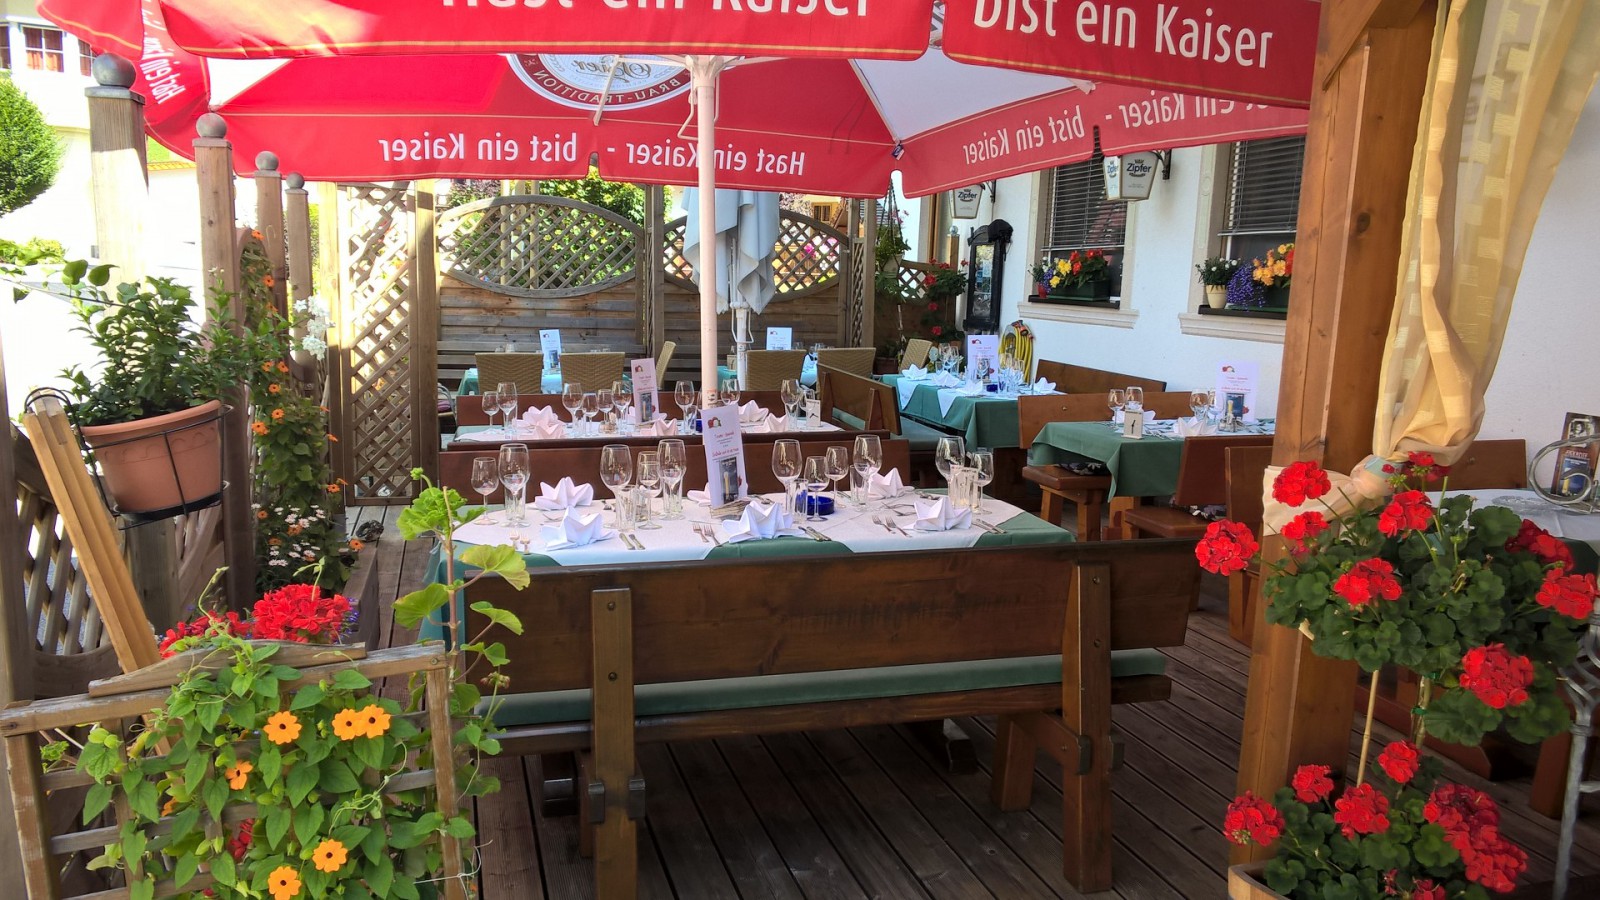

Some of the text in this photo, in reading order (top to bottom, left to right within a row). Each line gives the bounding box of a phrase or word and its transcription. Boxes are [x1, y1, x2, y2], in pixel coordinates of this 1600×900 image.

[1076, 0, 1137, 49] ein
[1155, 4, 1273, 68] Kaiser
[1126, 162, 1152, 173] Zipfer
[957, 191, 978, 200] Zipfer
